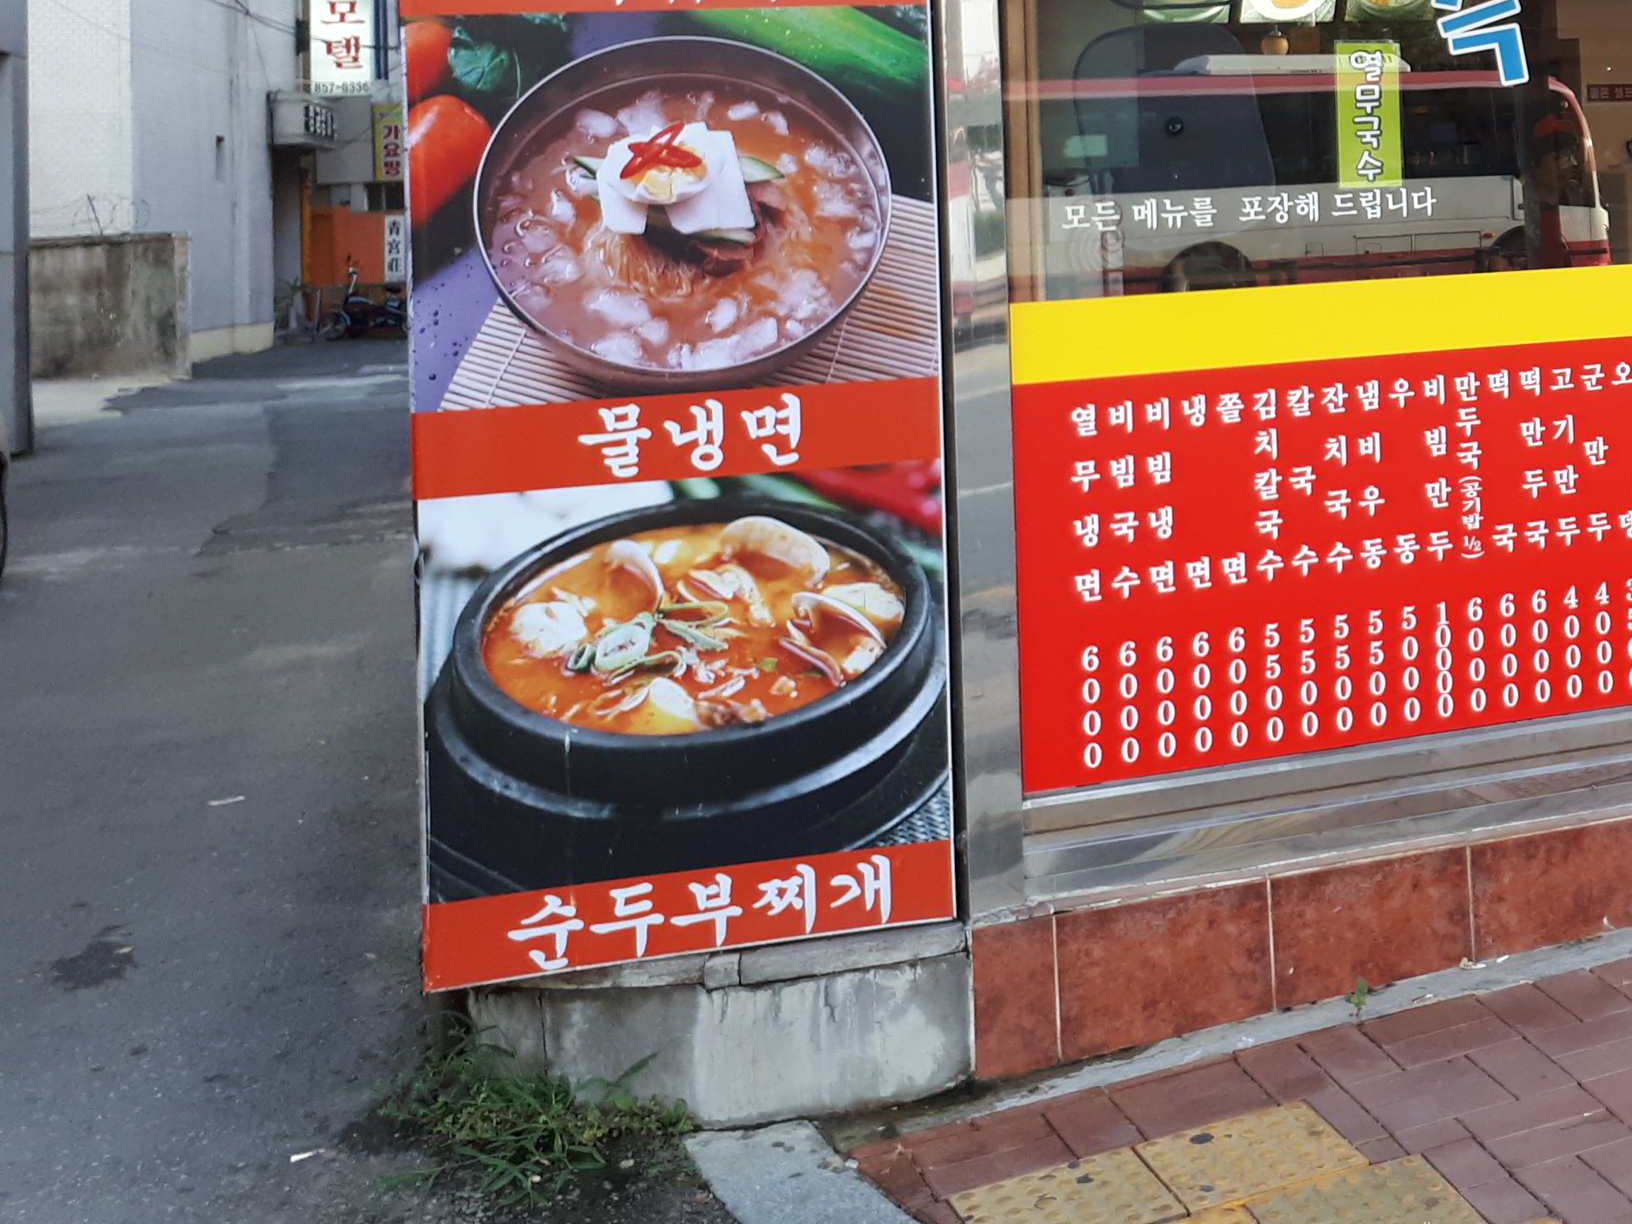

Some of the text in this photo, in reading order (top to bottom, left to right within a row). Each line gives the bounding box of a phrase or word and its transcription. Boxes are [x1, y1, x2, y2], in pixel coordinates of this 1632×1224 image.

[1061, 186, 1438, 232] 모든 메뉴를 포장해 드립니다
[1350, 50, 1385, 183] 열무국수
[578, 391, 802, 477] 물냉면
[1071, 404, 1102, 768] 열무냉면 6000
[1108, 401, 1140, 762] 비빔국수 6000
[1145, 397, 1176, 757] 비빔냉면 6000
[1253, 389, 1284, 741] 김치칼국수 5500
[1287, 386, 1319, 736] 칼국수 5500
[1321, 383, 1353, 731] 잔치국수 5500
[1356, 380, 1387, 726] 냄비우동 5500
[1423, 375, 1453, 717] 비빔만두 10000
[1519, 367, 1550, 702] 떡만두국 6000
[1550, 368, 1582, 698] 고기만두 4000
[1581, 364, 1613, 693] 군만두 4000
[1193, 632, 1212, 752] 6000
[1229, 627, 1248, 747] 6000
[1402, 606, 1420, 721] 5000
[1468, 597, 1486, 712] 6000
[1500, 593, 1518, 707] 6000
[507, 853, 893, 971] 순두부찌개
